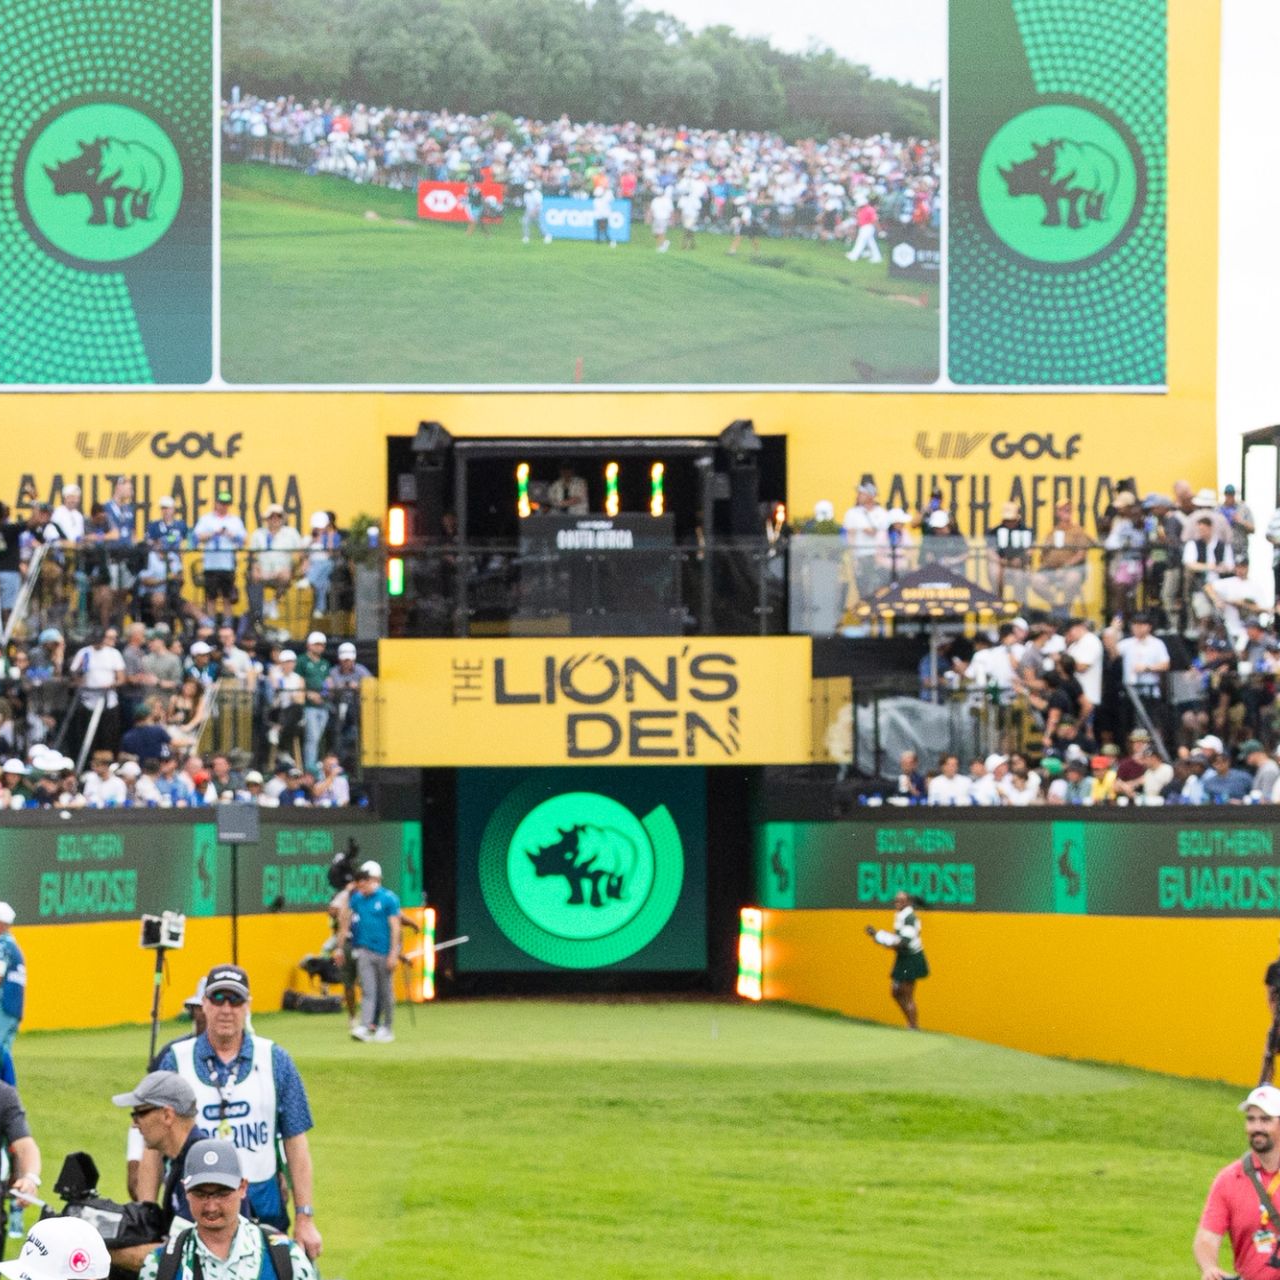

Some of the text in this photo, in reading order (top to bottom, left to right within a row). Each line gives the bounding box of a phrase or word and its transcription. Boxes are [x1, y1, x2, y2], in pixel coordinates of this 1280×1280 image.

[545, 208, 624, 230] aramo
[75, 431, 243, 459] LIV GOLF
[915, 431, 1082, 459] LIV GOLF
[16, 473, 151, 538] SUH
[856, 473, 1140, 538] OTH AFRIC
[453, 646, 739, 706] THE LION'S
[567, 707, 740, 759] DEN
[1178, 829, 1273, 857] SOUTHERN
